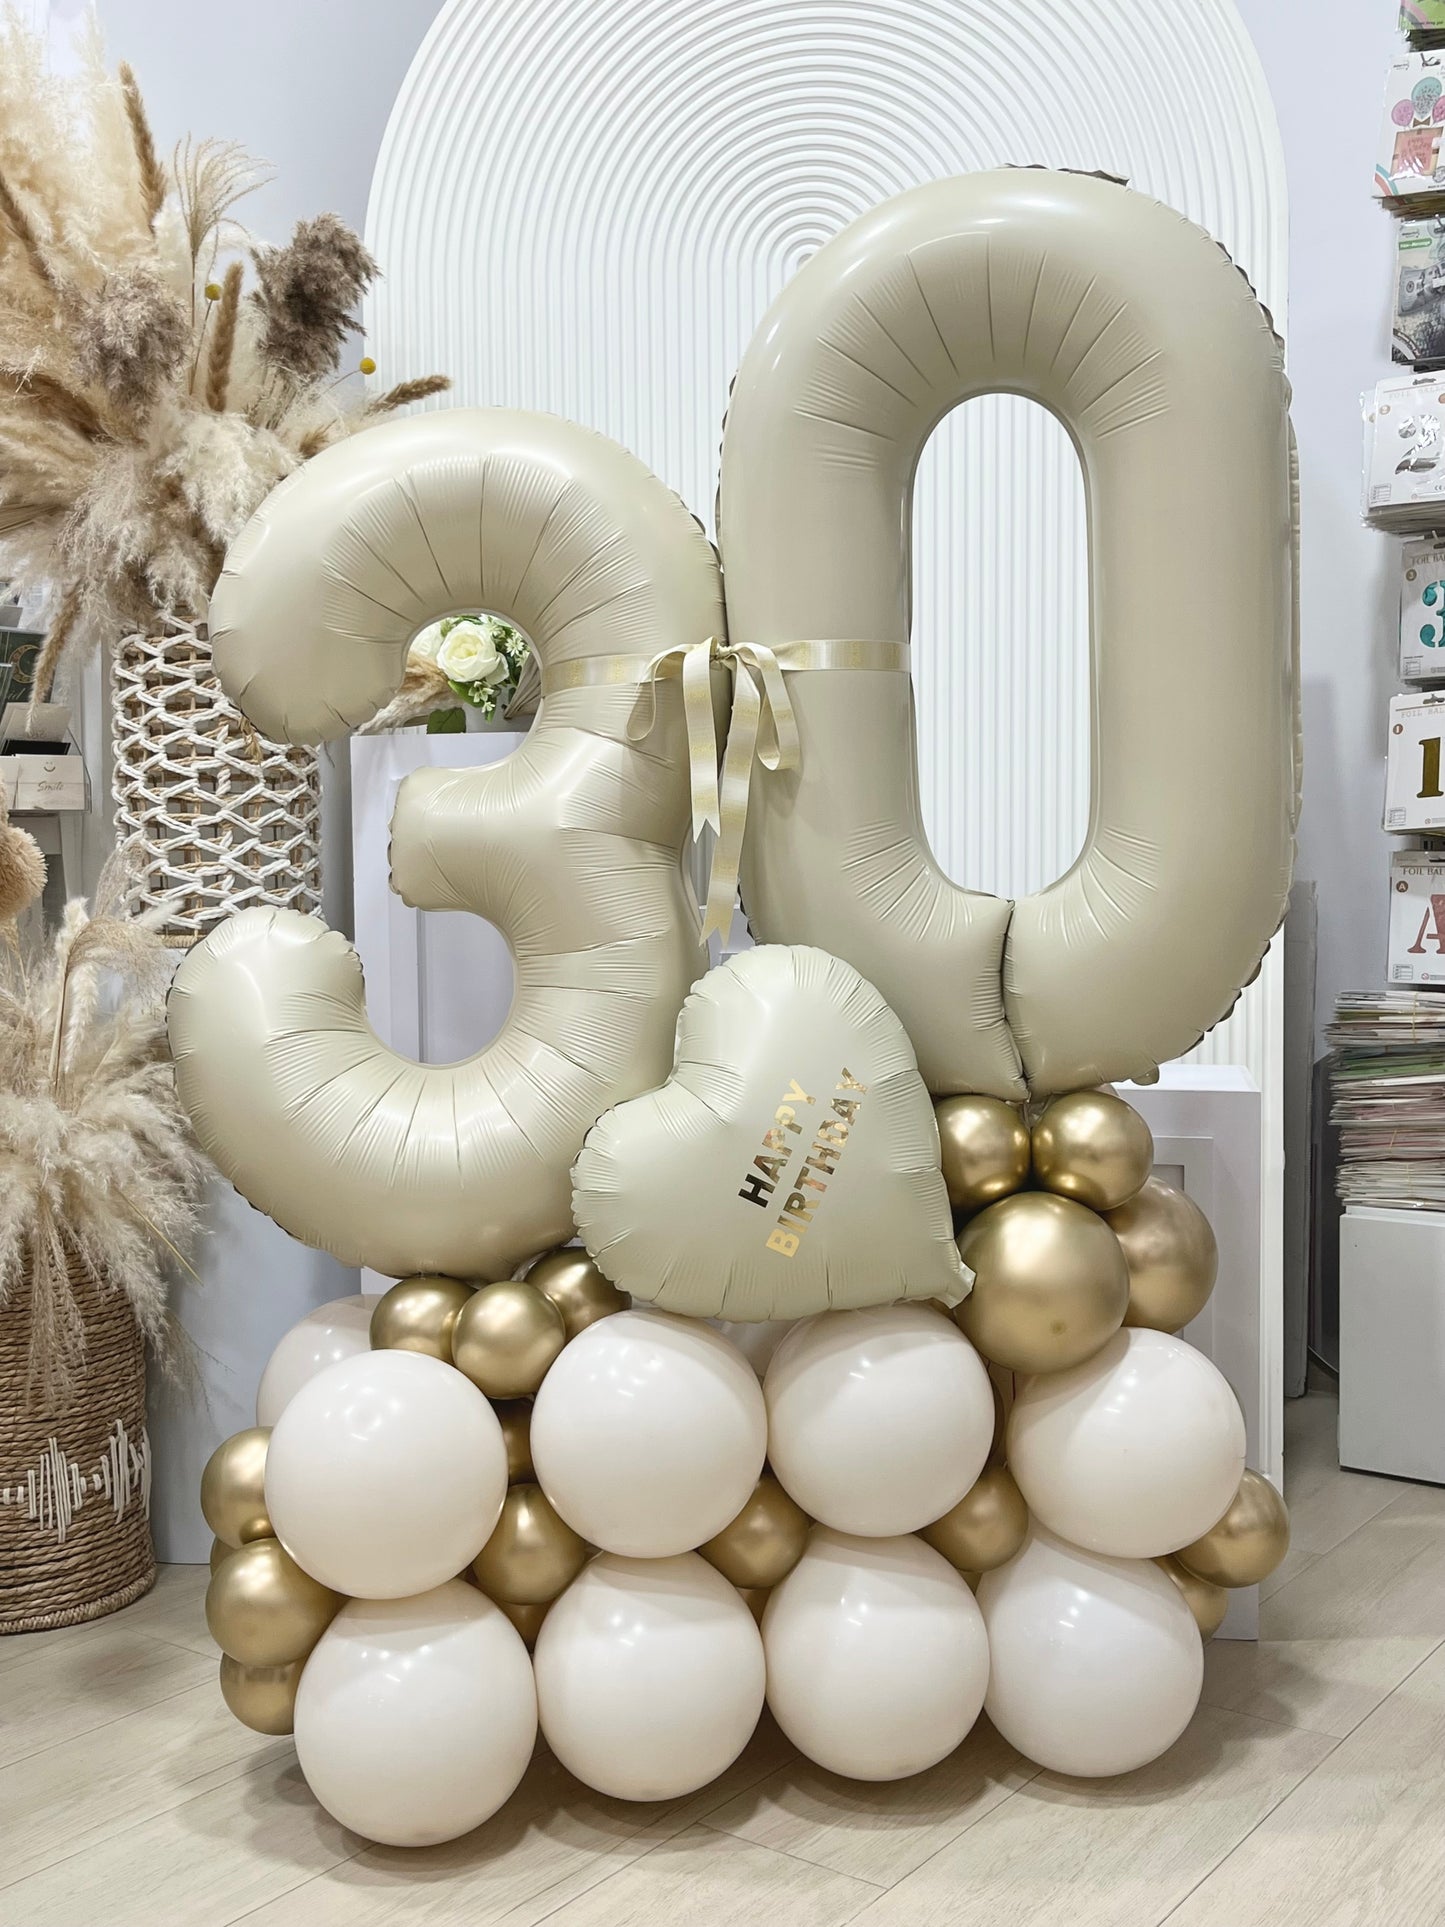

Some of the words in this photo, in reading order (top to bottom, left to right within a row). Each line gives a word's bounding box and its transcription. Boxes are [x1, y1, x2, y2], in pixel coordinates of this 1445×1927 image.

[37, 781, 63, 792] Smile
[1416, 736, 1444, 798] 1
[1403, 867, 1424, 875] FOIL
[1407, 894, 1445, 954] A
[738, 1078, 816, 1208] HAPPY
[766, 1067, 869, 1258] BIRTHDAY
